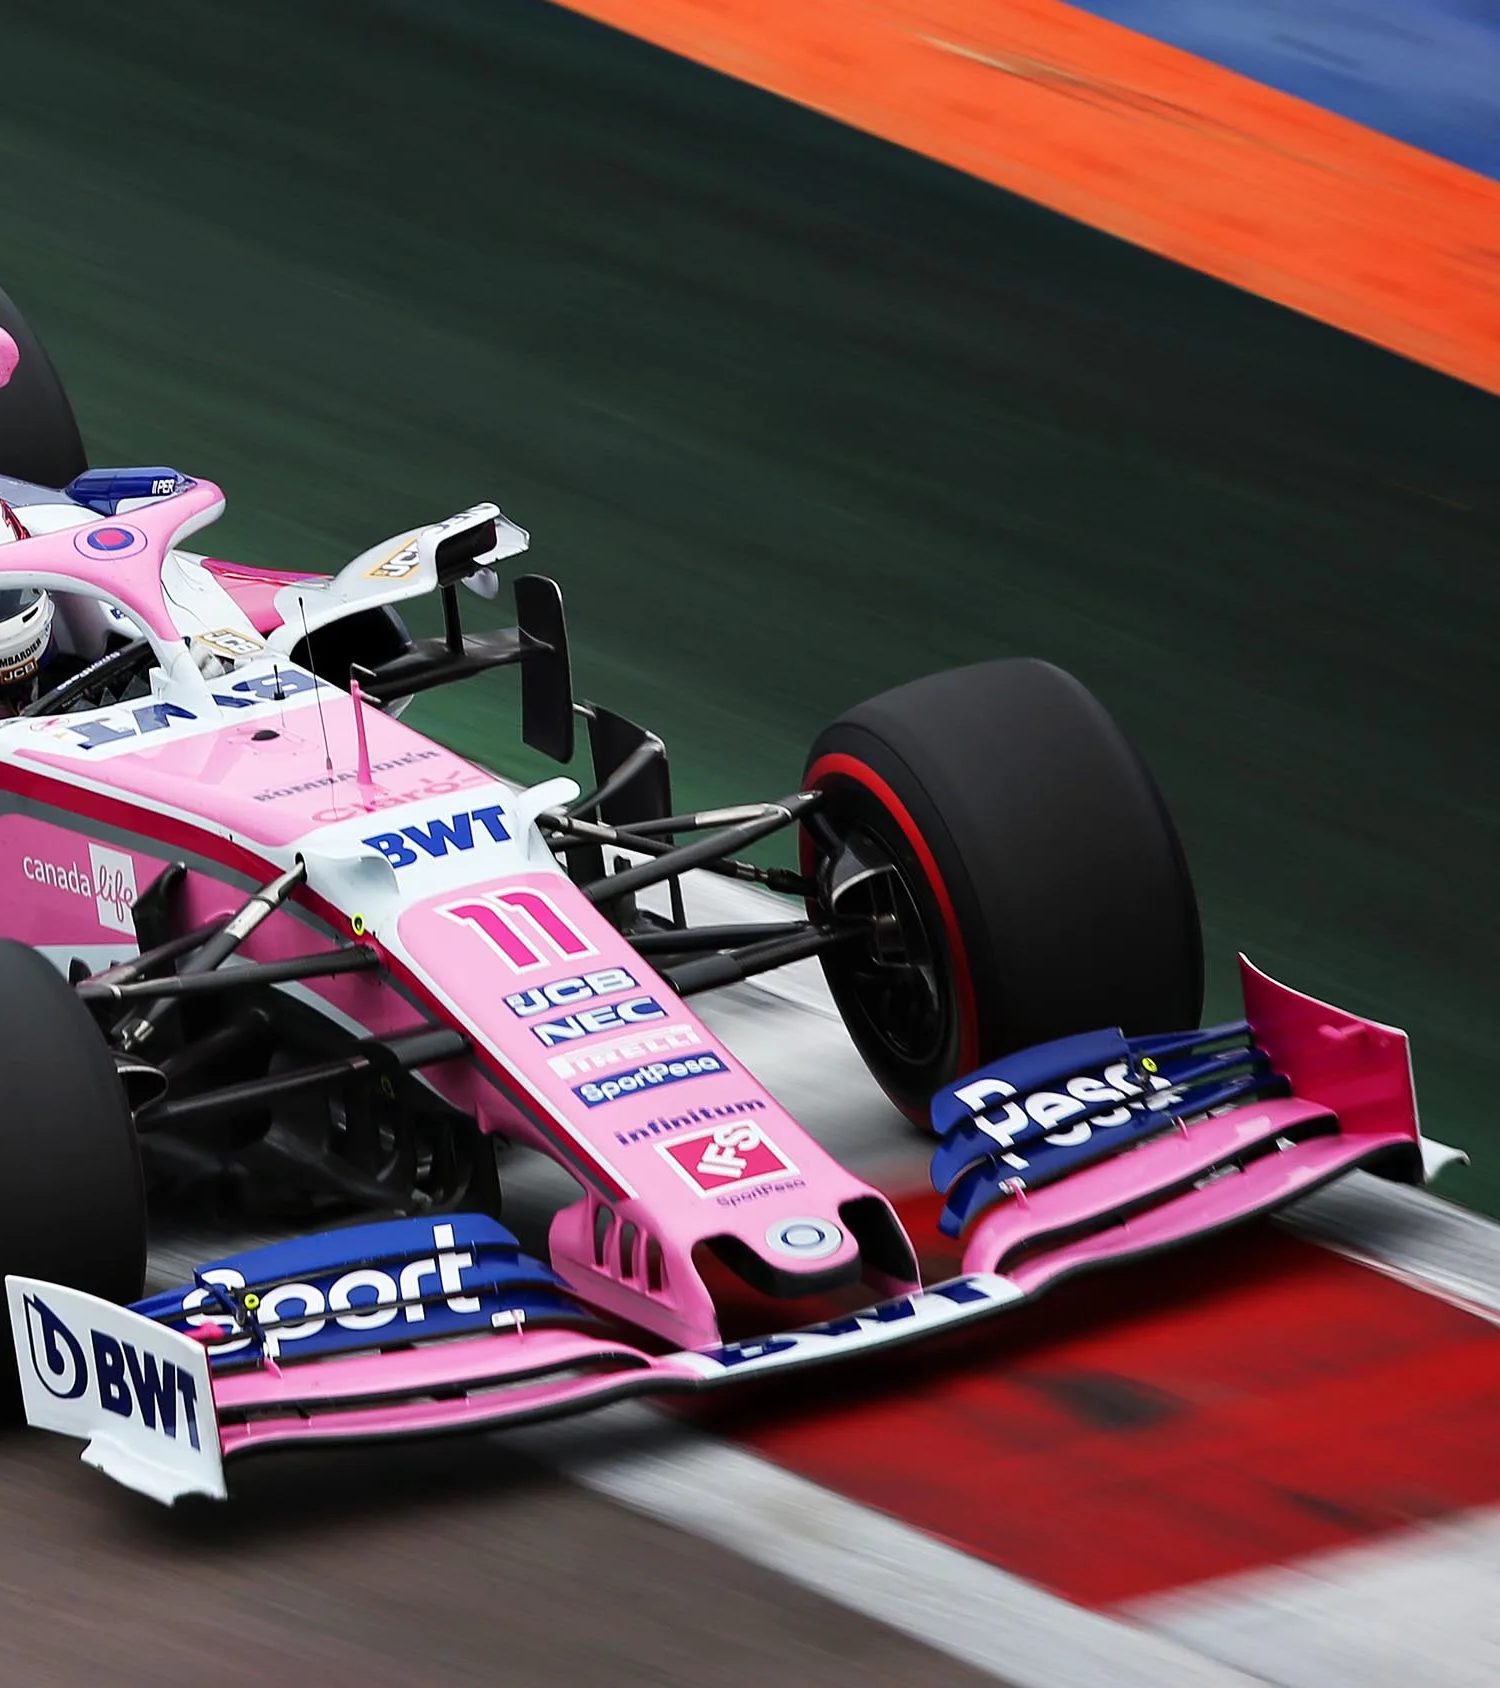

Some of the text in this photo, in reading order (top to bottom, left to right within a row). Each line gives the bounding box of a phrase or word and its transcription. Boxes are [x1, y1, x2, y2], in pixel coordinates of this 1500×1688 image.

[381, 540, 420, 577] JC
[3, 661, 37, 682] JCB
[253, 750, 441, 802] BOMBADIER
[362, 805, 512, 869] BWT
[23, 856, 134, 924] canada life
[432, 885, 600, 975] 11
[507, 967, 638, 1017] JCB
[533, 996, 667, 1047] NEC
[579, 1056, 721, 1102] SportPesa
[615, 1099, 767, 1146] infinitum
[696, 1123, 762, 1179] IFS
[181, 1223, 481, 1360] Sport
[91, 1328, 203, 1453] BWT
